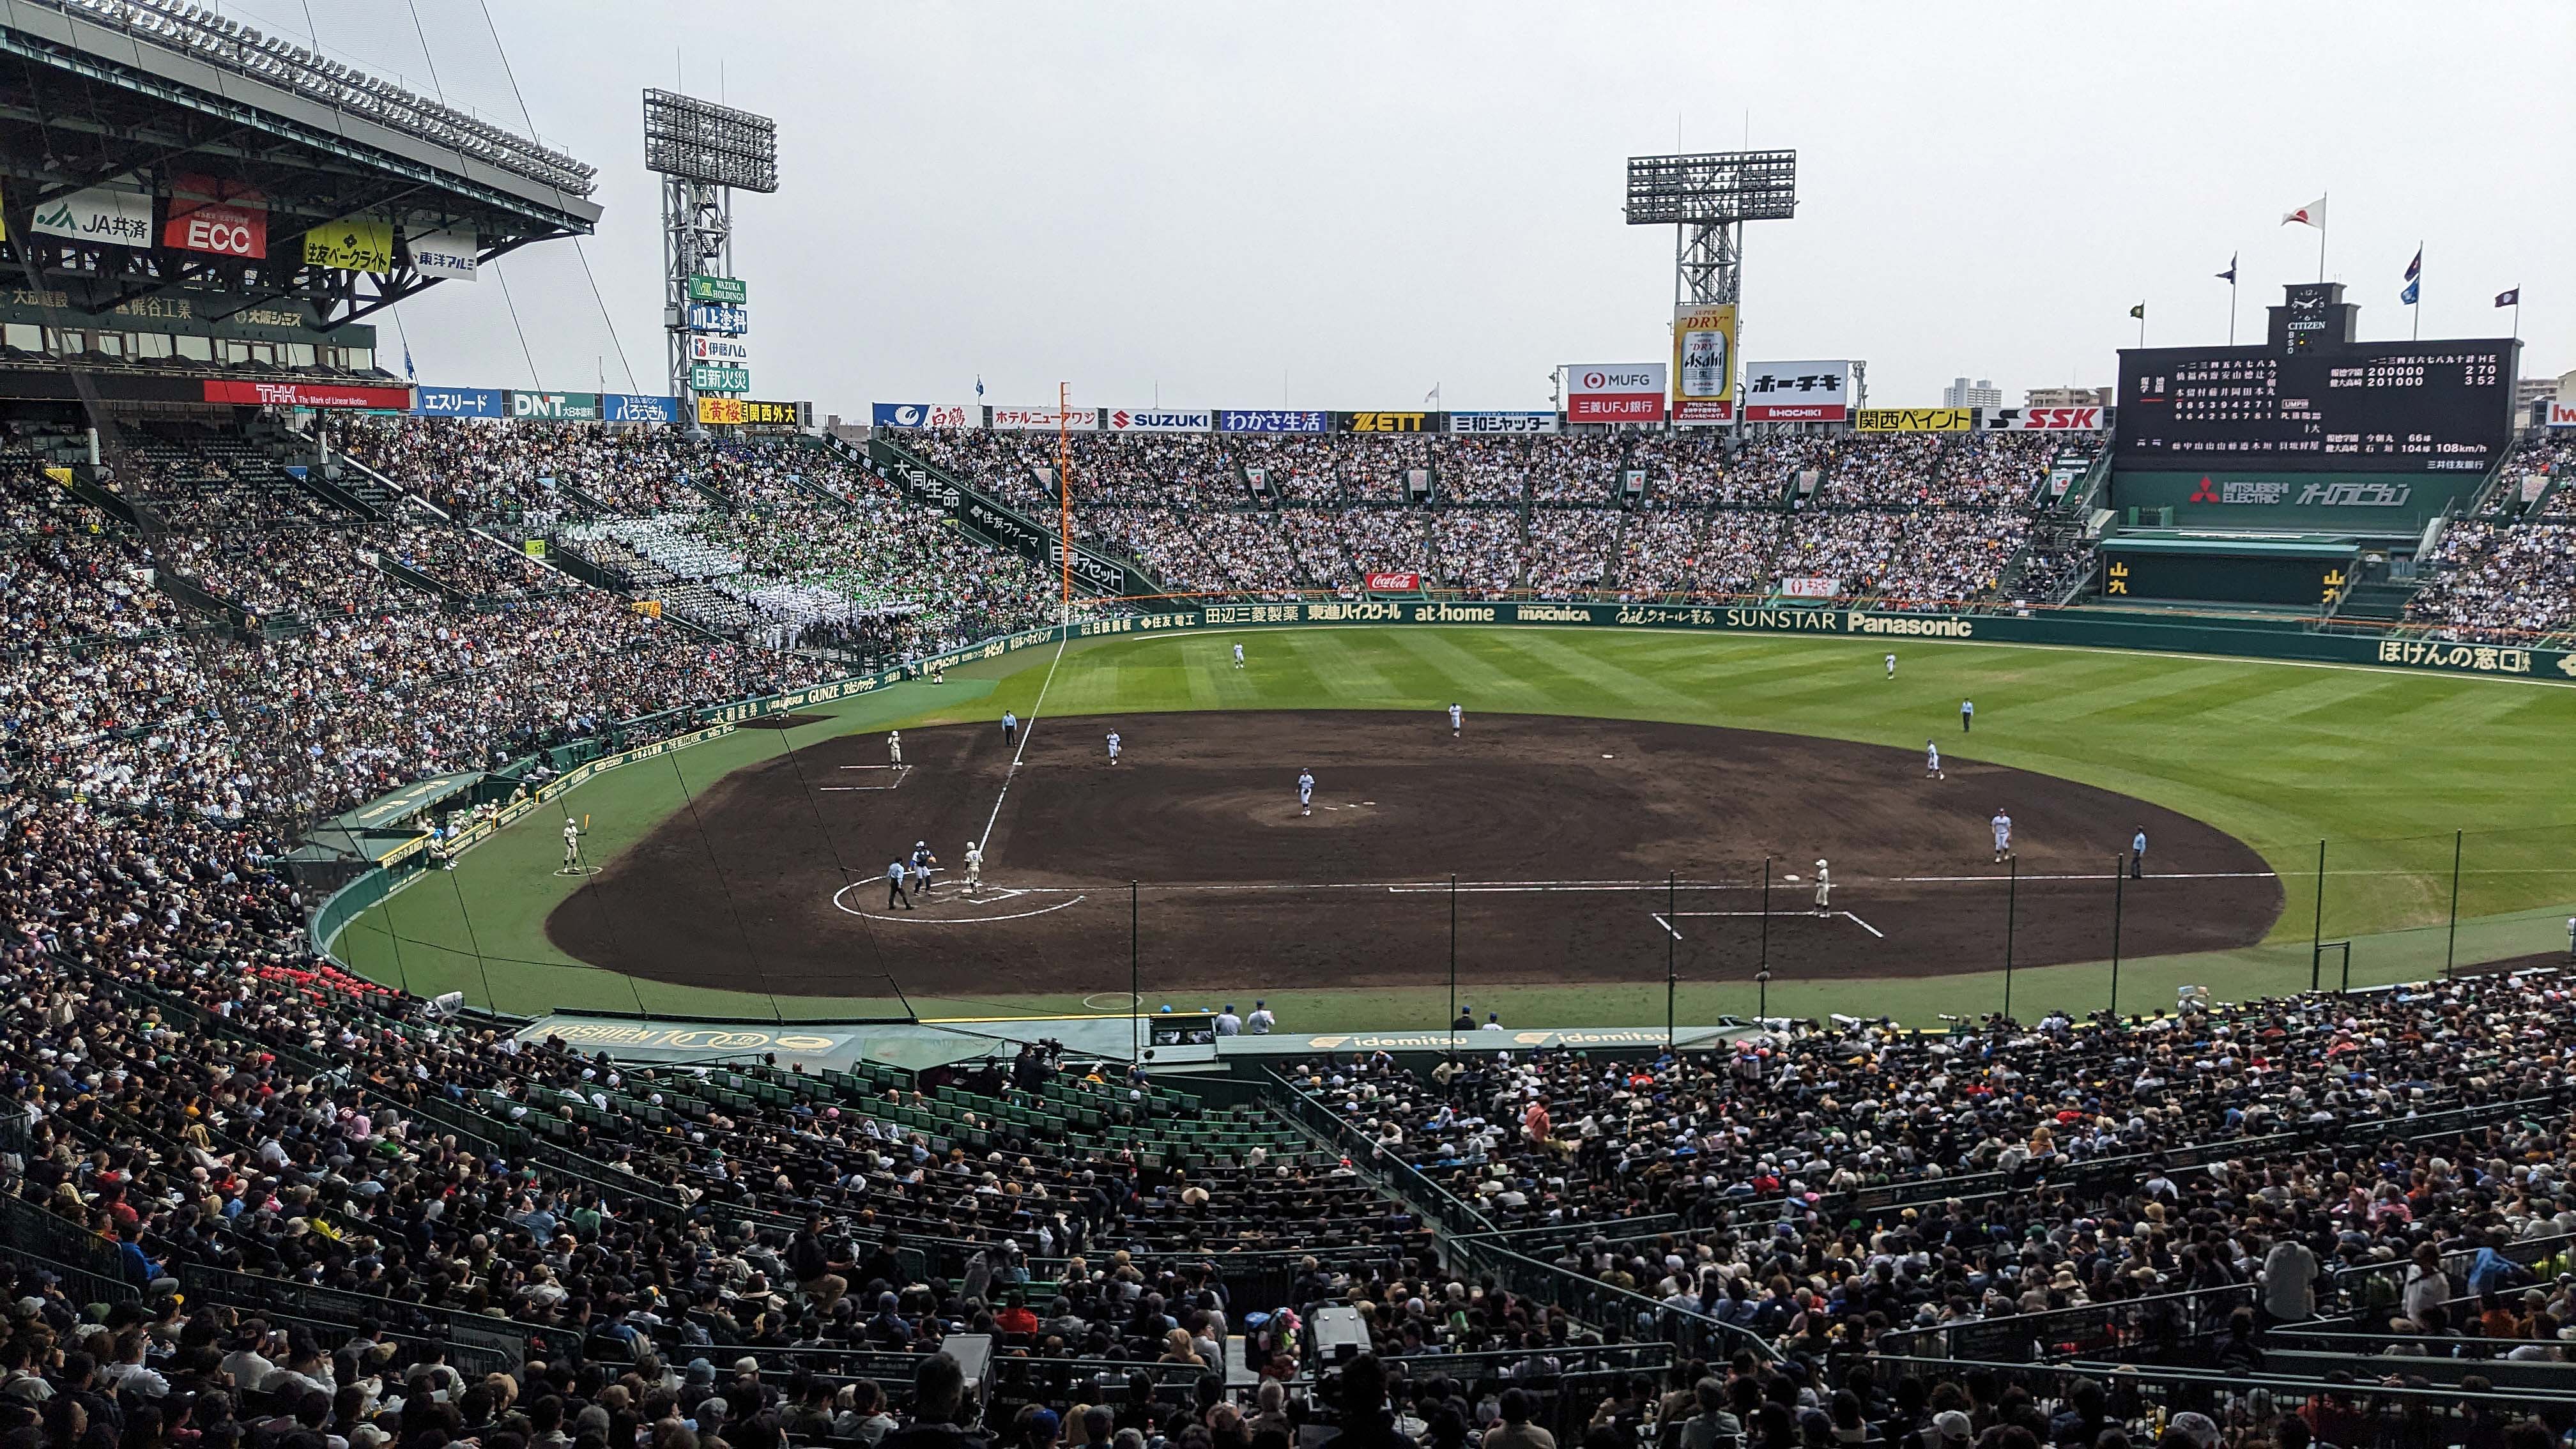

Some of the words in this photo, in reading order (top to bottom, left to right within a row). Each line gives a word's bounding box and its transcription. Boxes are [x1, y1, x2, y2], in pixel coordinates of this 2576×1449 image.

[82, 214, 148, 240] JA共済
[188, 220, 250, 253] ECC
[307, 242, 387, 272] 住友ベークライト
[418, 251, 474, 271] 東洋アルミ
[716, 280, 740, 291] WAZUKA
[712, 290, 745, 302] HOLDINGS
[693, 307, 747, 332] 川上塗料
[2288, 321, 2326, 330] CITIZEN
[708, 342, 747, 358] 伊藤ハム
[1685, 351, 1722, 368] Asahi
[695, 367, 747, 389] 日新火災
[1609, 374, 1650, 386] MUFG
[1752, 374, 1841, 392] ホーチキ
[256, 384, 296, 403] THK
[310, 395, 325, 404] Mark
[332, 397, 348, 405] Linear
[349, 397, 367, 406] Motion
[425, 394, 488, 413] エスリード
[515, 394, 566, 417] DNT
[563, 407, 594, 418] 大日本塗料
[629, 404, 668, 420] ろうきん
[709, 400, 740, 422] 黄桜
[1578, 401, 1653, 414] 三菱UFJ銀行
[1776, 408, 1821, 417] HOCHIKI
[749, 404, 795, 423] 関西外大
[931, 406, 966, 427] 白鶴
[995, 411, 1095, 425] ホテルニューアワジ
[1134, 414, 1208, 427] SUZUKI
[1227, 411, 1321, 431] わかさ生活
[1353, 413, 1425, 432] ZETT
[1860, 410, 1969, 429] 関西ペイント
[2024, 408, 2099, 429] SSK
[1456, 417, 1550, 431] 三和シャッター
[2436, 443, 2487, 453] 108km/h
[2428, 460, 2485, 470] 三井住友銀行
[894, 459, 960, 509] 大同生命
[2223, 482, 2289, 493] MITSUBISHI
[2223, 493, 2280, 504] ELECTRIC
[983, 510, 1039, 548] 住友ファーマ
[1052, 545, 1122, 587] 日興アセット
[2109, 562, 2128, 594] 山九
[2322, 569, 2345, 604] 山九
[1206, 606, 1299, 624] 田辺三菱製薬
[1308, 604, 1401, 621] 東進ハイスクール
[1414, 605, 1436, 622] at
[1440, 602, 1494, 622] home
[1726, 609, 1836, 630] SUNSTAR
[1848, 613, 1972, 638] Panasonic
[984, 640, 1005, 659] オービック
[2378, 640, 2522, 673] ほけんの窓口
[808, 684, 840, 704] GUNZE
[714, 702, 758, 723] 大和証券
[534, 1025, 659, 1043] KOSHIEN
[1353, 1035, 1468, 1047] idemitsu
[1559, 1031, 1671, 1044] idemitsu
